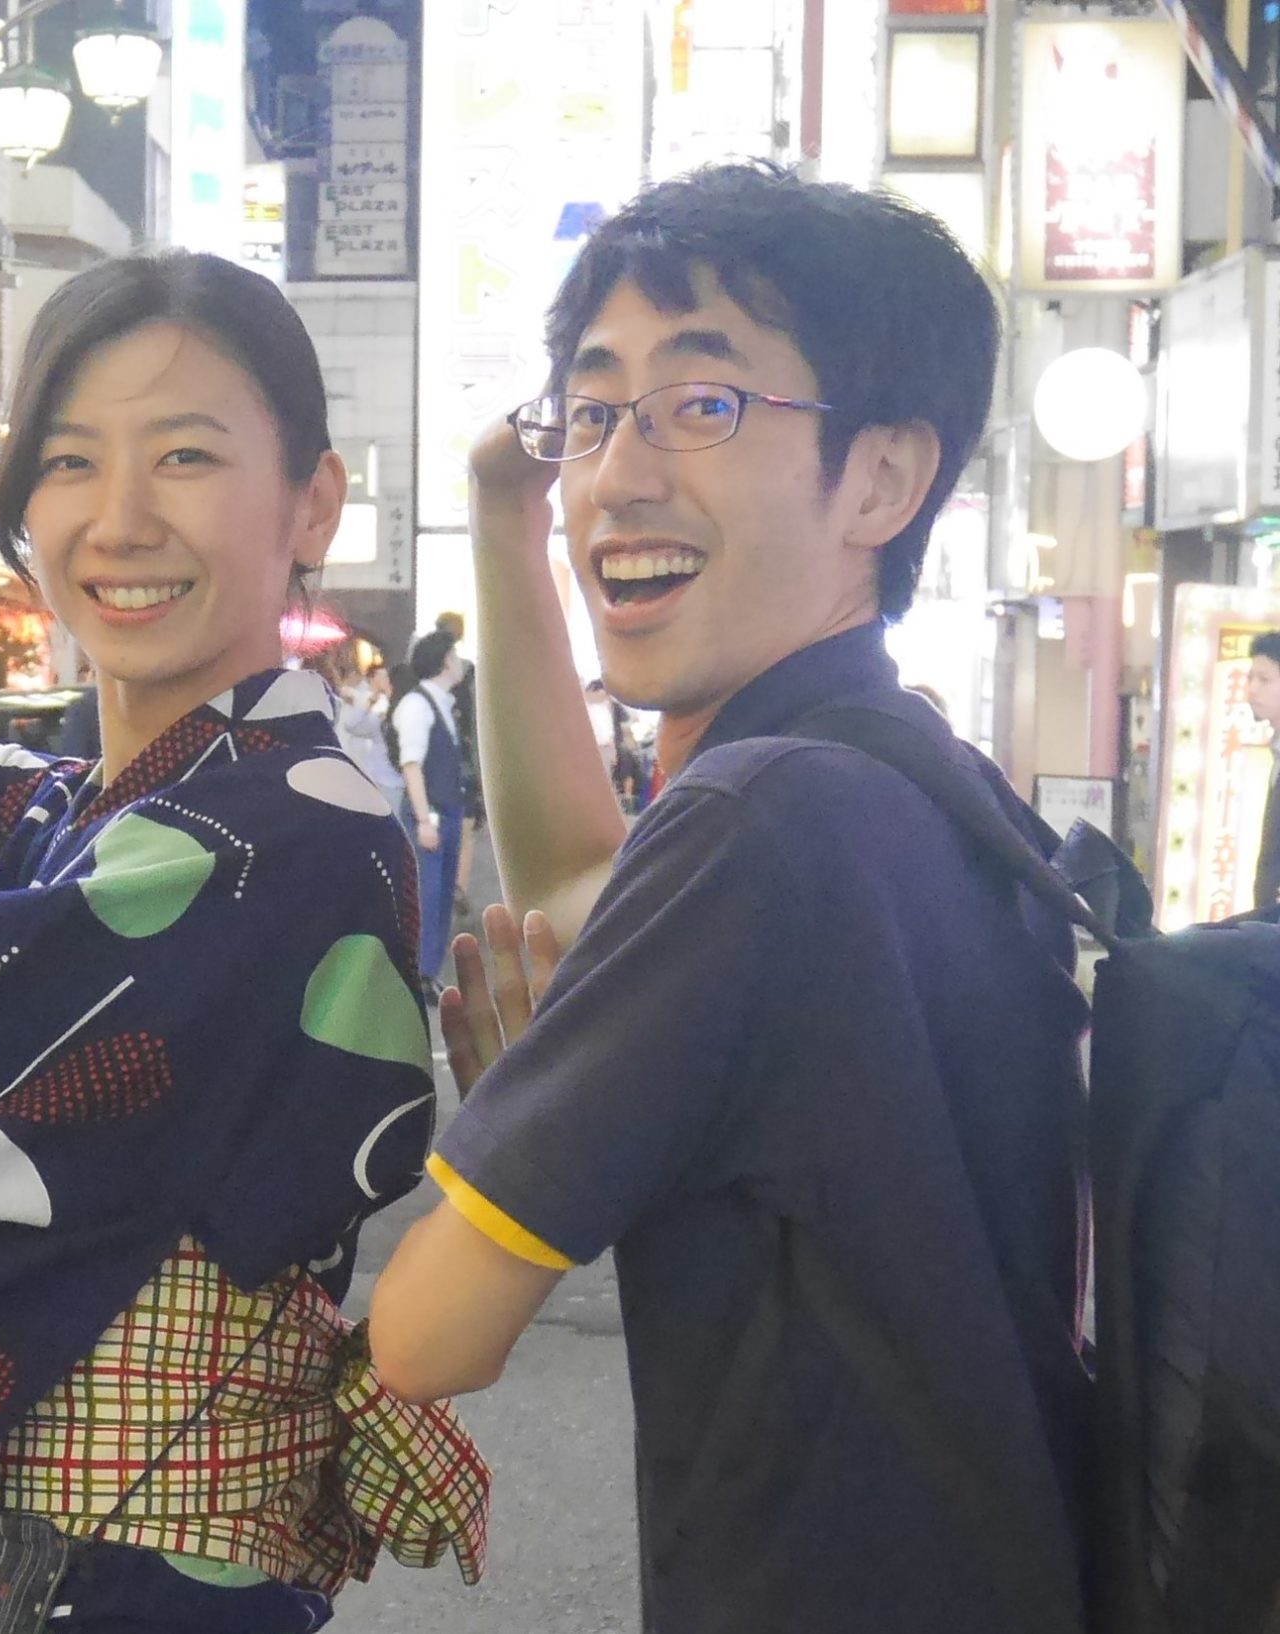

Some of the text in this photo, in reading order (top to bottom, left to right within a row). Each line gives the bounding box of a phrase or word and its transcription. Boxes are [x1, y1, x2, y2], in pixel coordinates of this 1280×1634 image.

[325, 185, 376, 201] EAST
[335, 200, 399, 216] PLAZA
[324, 225, 375, 242] EAST
[334, 239, 399, 257] PLAZA
[444, 0, 527, 512] レストラ
